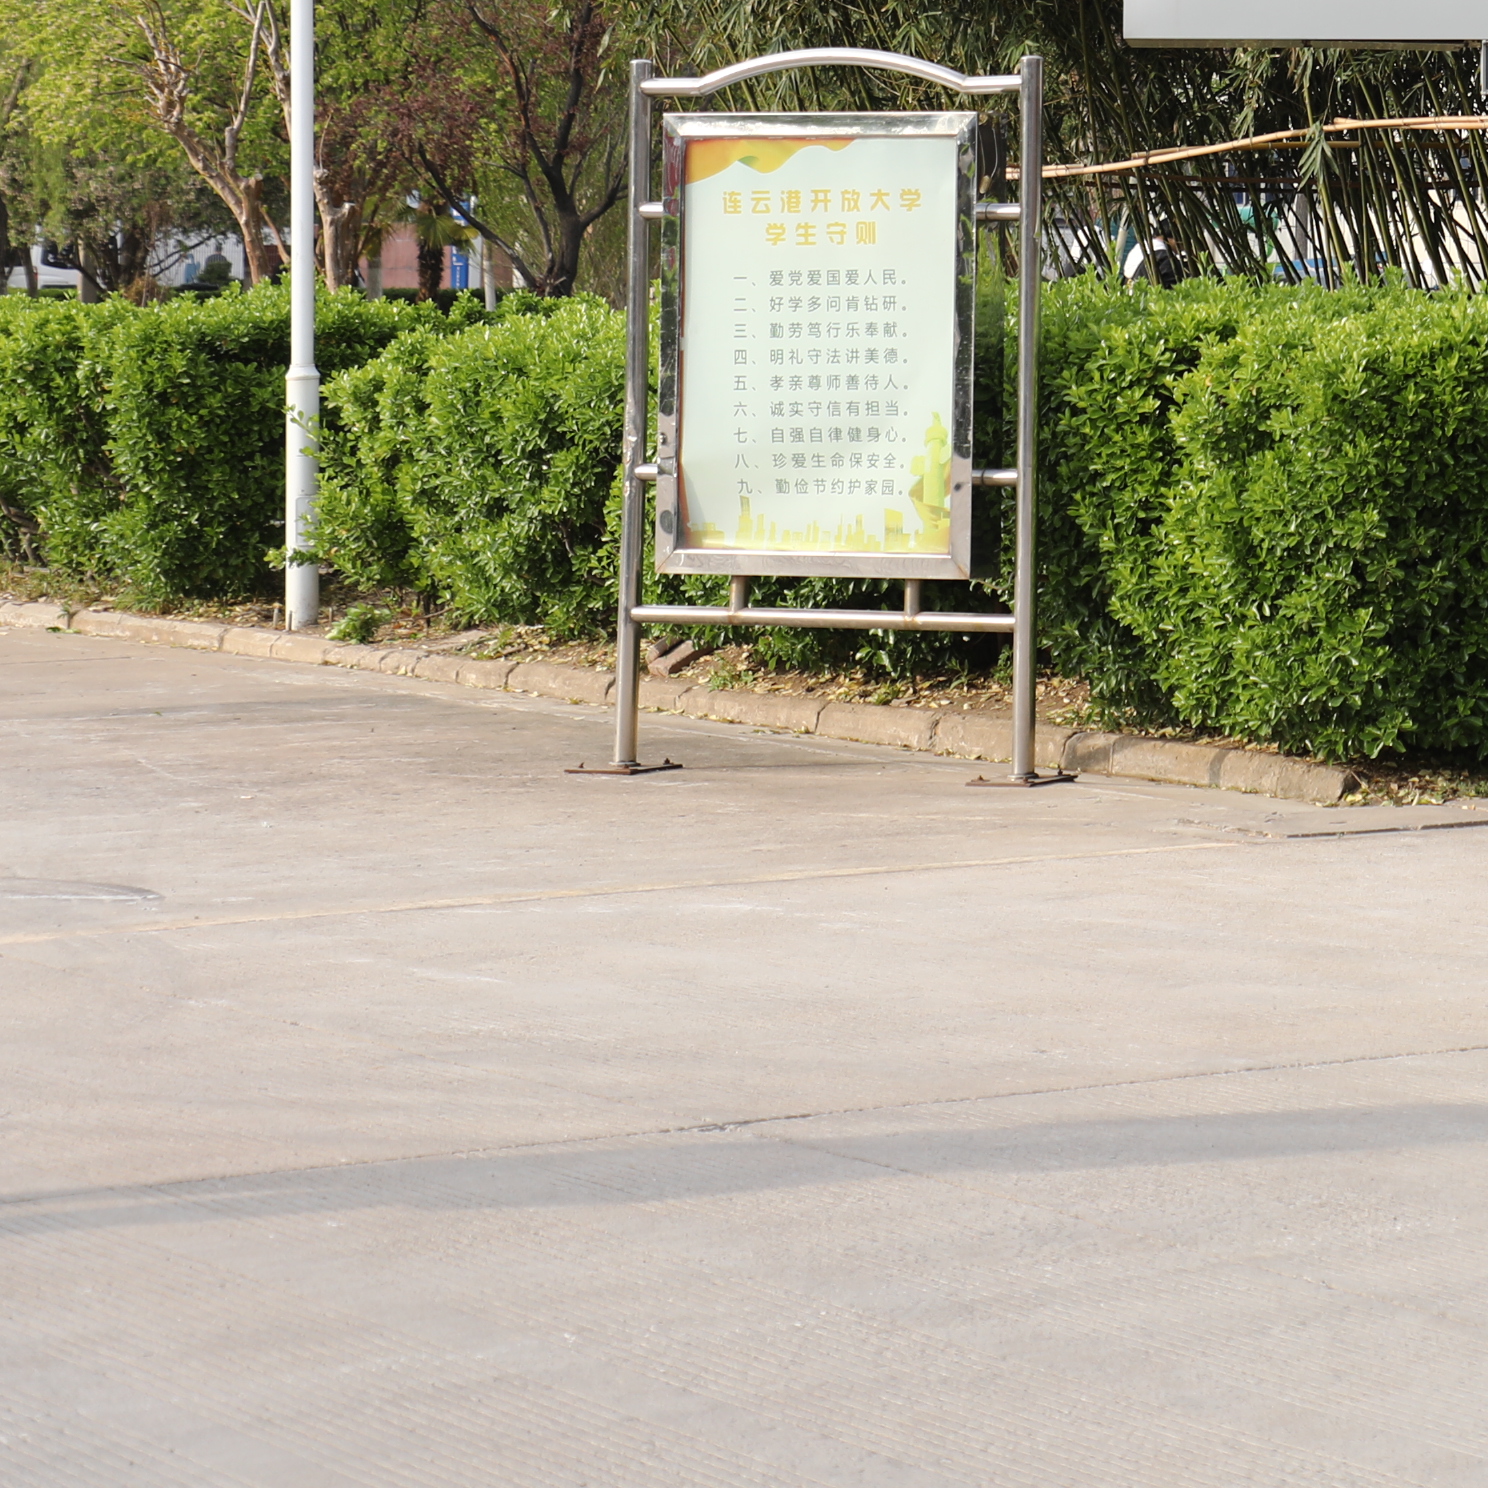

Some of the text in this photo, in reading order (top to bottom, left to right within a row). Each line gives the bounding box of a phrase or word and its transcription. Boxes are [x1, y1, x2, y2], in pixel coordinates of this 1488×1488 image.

[722, 188, 922, 214] 连云港开放大学
[765, 221, 877, 246] 学生守则
